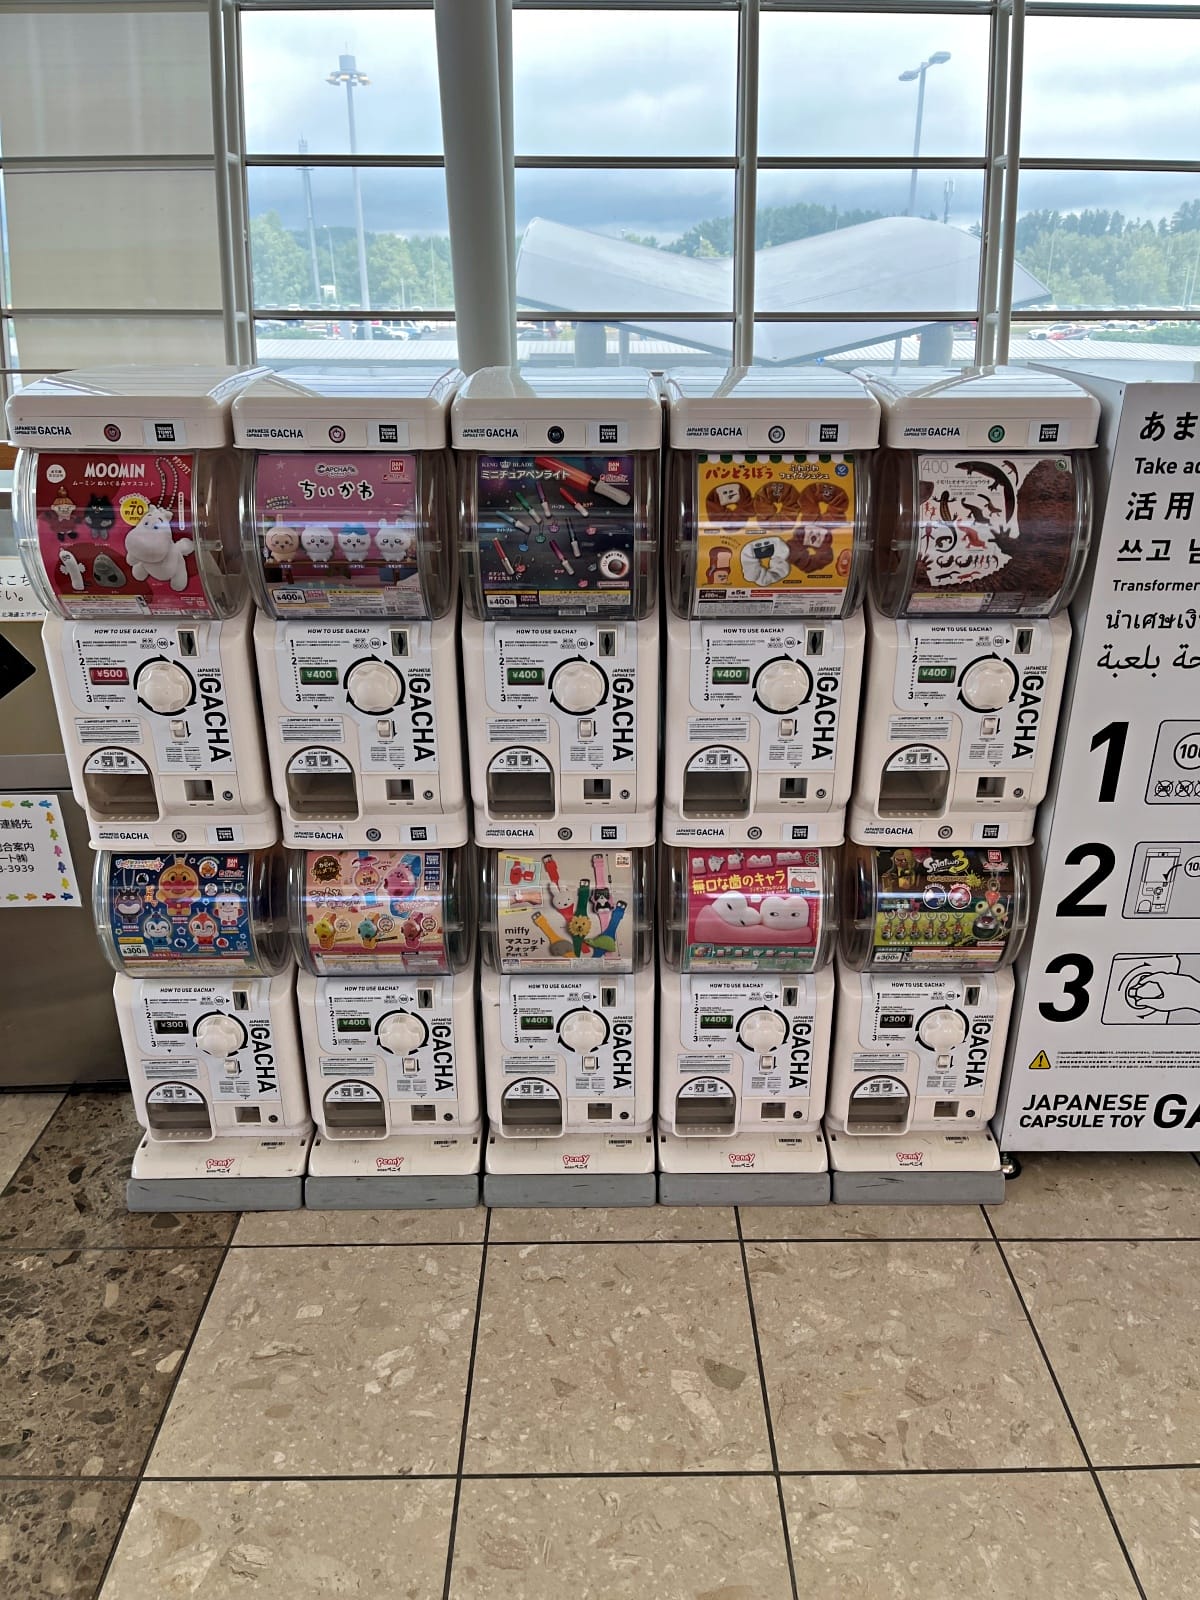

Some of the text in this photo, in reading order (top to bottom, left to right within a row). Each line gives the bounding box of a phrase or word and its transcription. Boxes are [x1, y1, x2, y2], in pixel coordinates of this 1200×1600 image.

[38, 426, 72, 435] GACHA
[1139, 410, 1198, 442] あま
[270, 429, 303, 438] GACHA
[486, 429, 519, 437] GACHA
[710, 427, 743, 436] GACHA
[928, 427, 961, 436] GACHA
[84, 462, 145, 478] MOOMIN
[923, 460, 948, 474] 400
[1134, 457, 1177, 475] Take
[481, 470, 571, 480] ミニチュアペンライト
[706, 465, 774, 479] パンどろぼう
[299, 480, 373, 499] ちいかわ
[1125, 491, 1195, 521] 活用
[1117, 539, 1171, 562] 쓰고
[76, 640, 81, 648] 1
[290, 640, 294, 648] 1
[499, 640, 503, 648] 1
[706, 639, 710, 647] 1
[914, 637, 919, 646] 1
[79, 657, 86, 666] 2
[291, 657, 297, 665] 2
[499, 657, 505, 666] 2
[705, 657, 711, 665] 2
[912, 655, 918, 663] 2
[1097, 644, 1160, 678] بلعبة
[86, 694, 93, 703] 3
[296, 694, 301, 702] 3
[500, 694, 506, 702] 3
[703, 693, 710, 701] 3
[907, 692, 914, 700] 3
[199, 678, 232, 762] GACHA
[408, 678, 436, 762] GACHA
[612, 678, 634, 761] GACHA
[811, 677, 839, 760] GACHA
[1011, 675, 1044, 759] GACHA
[1180, 744, 1200, 759] 10
[1090, 722, 1129, 802] 1
[314, 831, 344, 840] GACHA
[506, 829, 534, 837] GACHA
[885, 827, 913, 835] GACHA
[120, 832, 149, 840] GACHA
[692, 870, 785, 894] 無口な歯のキャラ
[1056, 842, 1116, 917] 2
[505, 927, 530, 935] miffy
[505, 937, 545, 945] マスコット
[1038, 953, 1094, 1022] 3
[152, 1040, 156, 1048] 3
[431, 1026, 454, 1091] GACHA
[613, 1023, 632, 1089] GACHA
[789, 1023, 812, 1089] GACHA
[964, 1022, 991, 1088] GACHA
[250, 1027, 277, 1093] GACHA
[1022, 1094, 1149, 1111] JAPANESE
[1019, 1114, 1146, 1128] CAPSULE TOY
